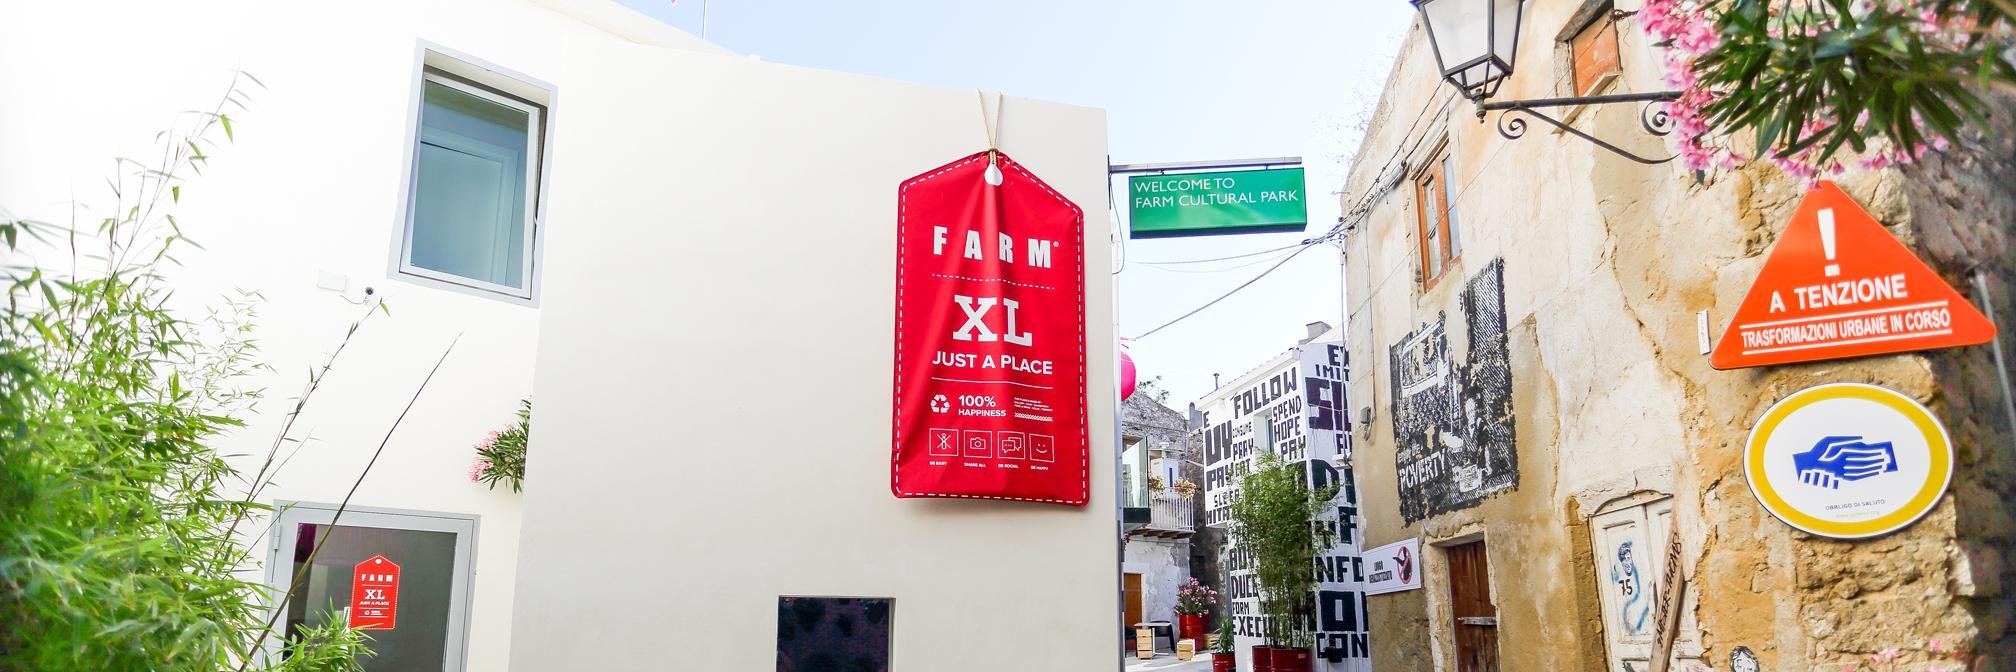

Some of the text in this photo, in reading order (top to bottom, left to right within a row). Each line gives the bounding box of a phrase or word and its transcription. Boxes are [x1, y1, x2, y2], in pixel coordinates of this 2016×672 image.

[1135, 178, 1235, 192] WELCOME TO
[1135, 190, 1298, 208] FARM CULTURAL PARK
[1769, 274, 1908, 313] A TENZIONE
[952, 294, 1033, 347] XL
[1741, 308, 1950, 348] TRASFORMAZIONI URBANE IN CORSO
[932, 350, 1053, 375] JUST A PLACE
[958, 394, 996, 408] 100%
[1233, 366, 1298, 420] FOLLOW
[958, 408, 1007, 417] HAPPINESS
[1272, 395, 1302, 423] SPEND
[1273, 415, 1301, 443] HOPE
[361, 573, 393, 582] FARM
[364, 589, 385, 600] XL
